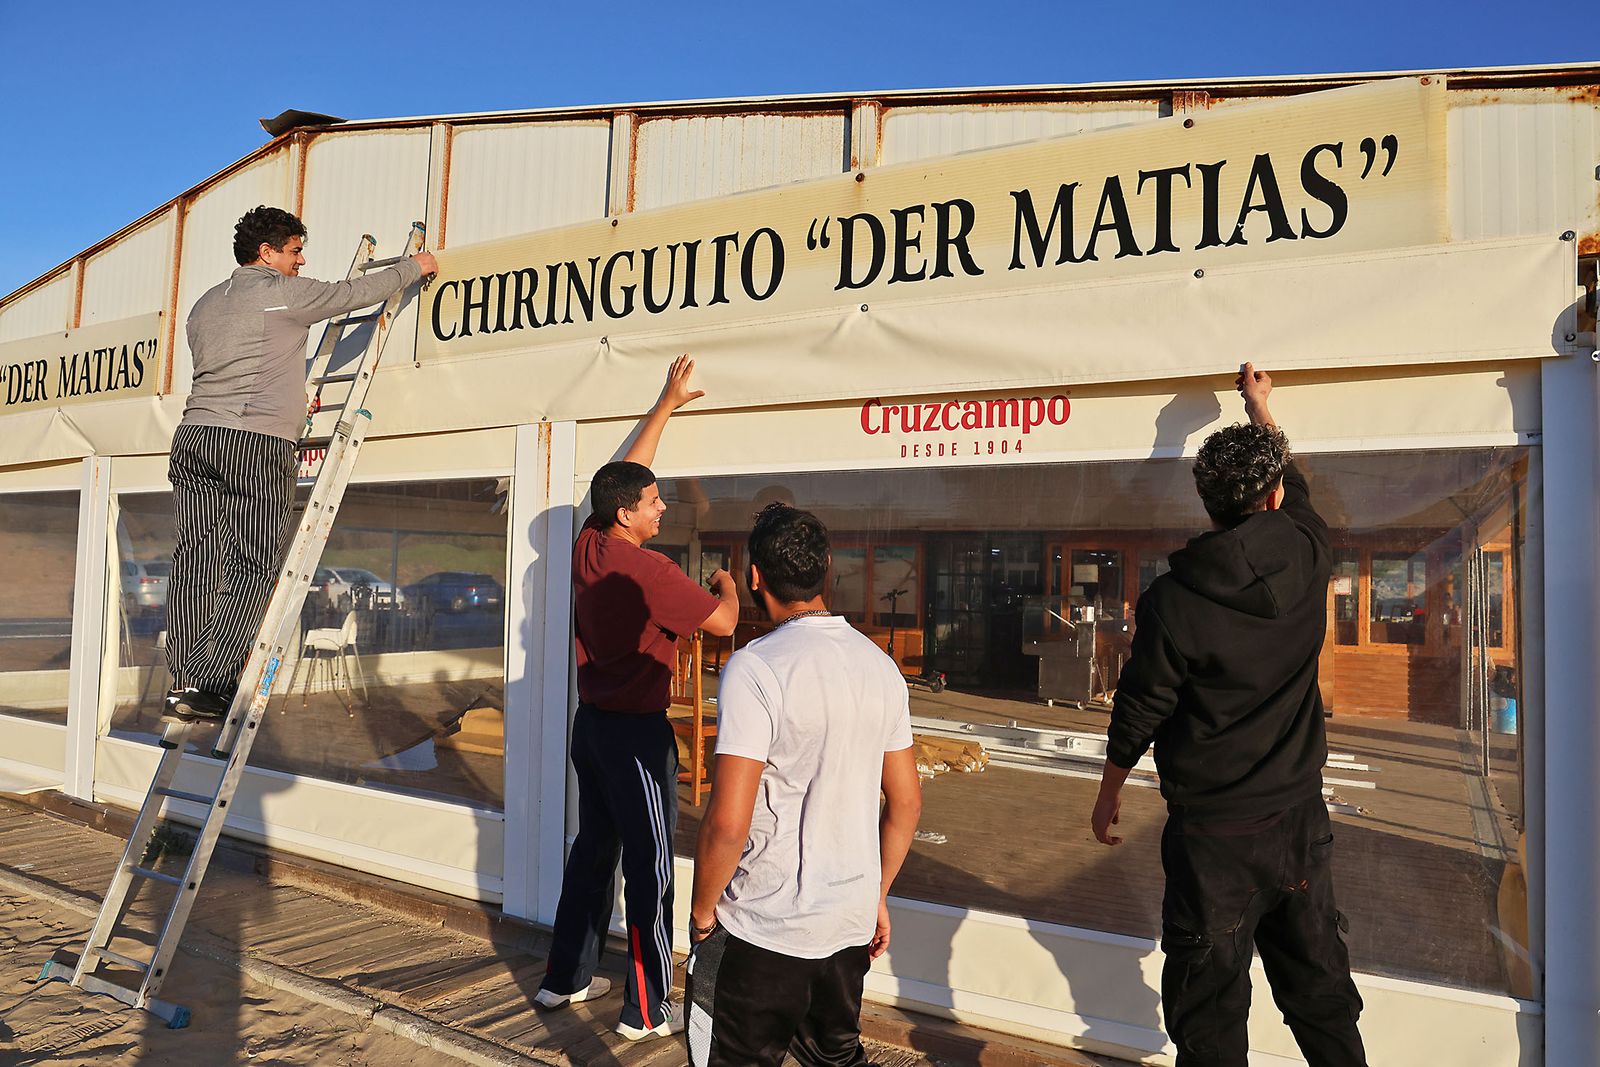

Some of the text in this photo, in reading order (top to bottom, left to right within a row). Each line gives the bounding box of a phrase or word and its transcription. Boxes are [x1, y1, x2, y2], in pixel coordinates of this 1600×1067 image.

[431, 226, 786, 342] CHIRINGUITO
[860, 394, 1071, 435] Cruzcampo
[900, 439, 1023, 458] DESDE 1904
